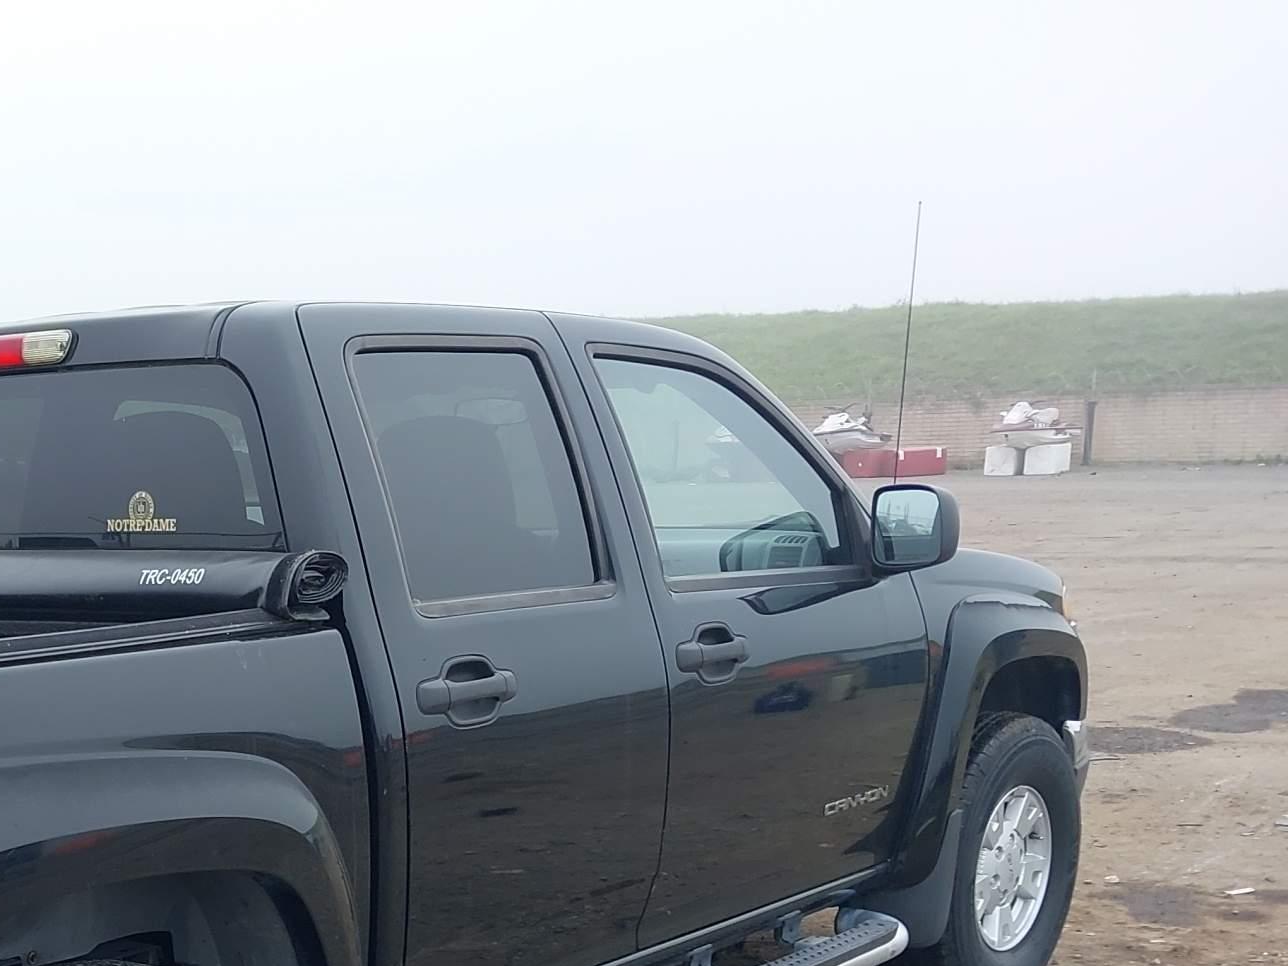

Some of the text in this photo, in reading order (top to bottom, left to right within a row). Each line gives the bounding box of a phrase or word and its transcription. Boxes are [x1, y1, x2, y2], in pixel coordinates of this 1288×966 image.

[106, 518, 177, 532] NOTRE DAME
[139, 568, 206, 585] TRC-0450
